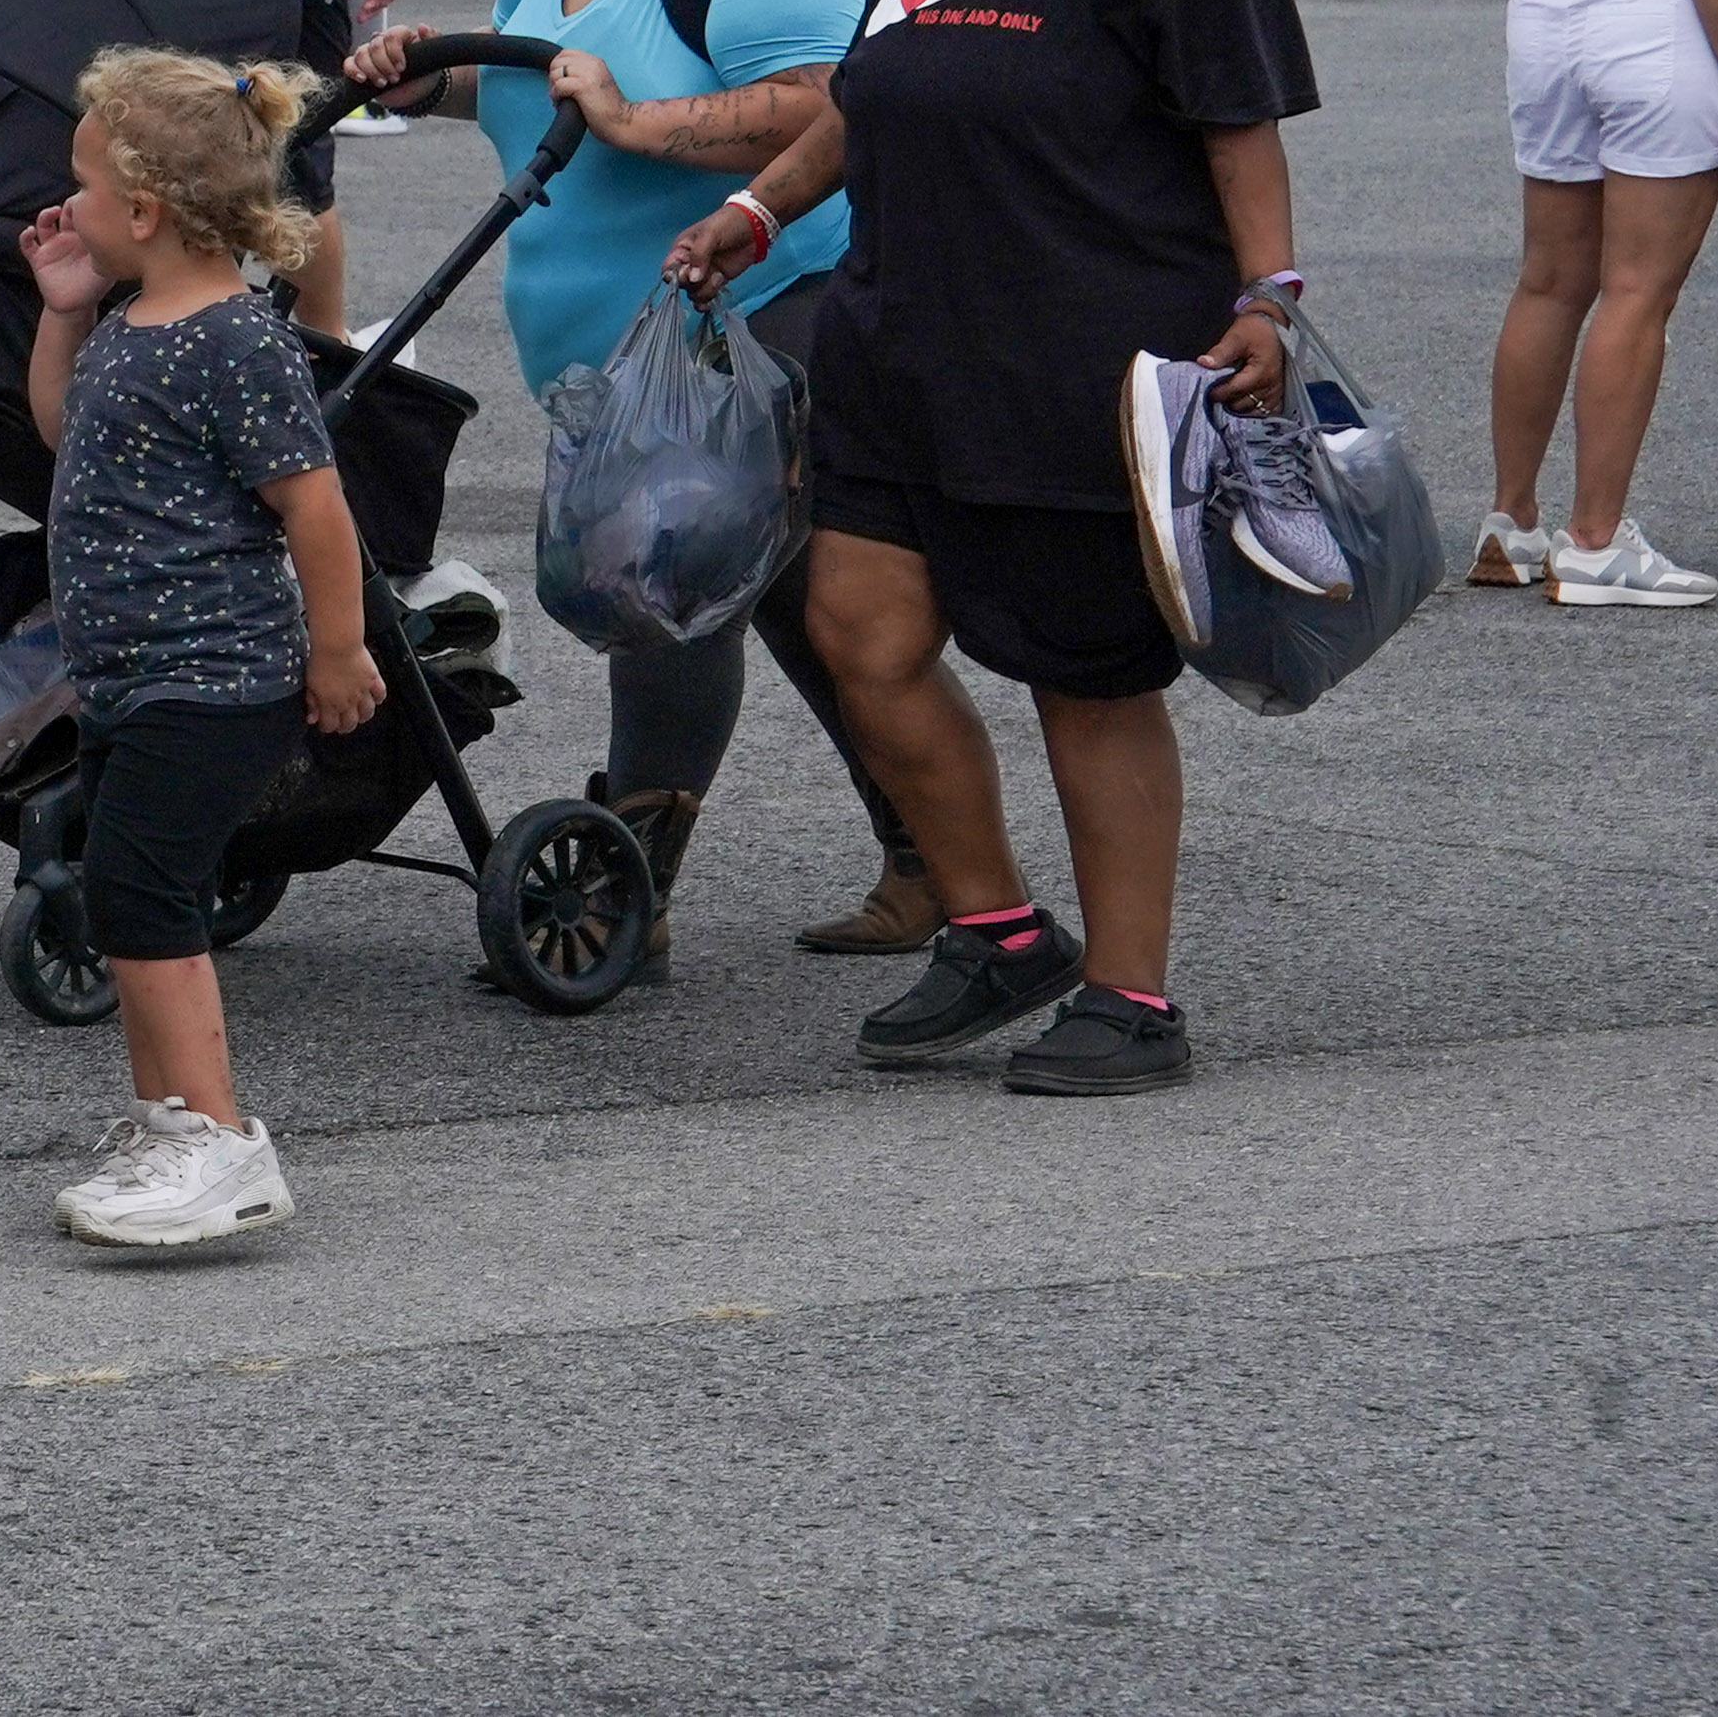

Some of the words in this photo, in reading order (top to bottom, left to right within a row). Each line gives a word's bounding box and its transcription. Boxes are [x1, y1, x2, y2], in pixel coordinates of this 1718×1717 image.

[915, 9, 941, 25] HIS
[965, 8, 998, 26] AND
[999, 11, 1043, 33] ONLY
